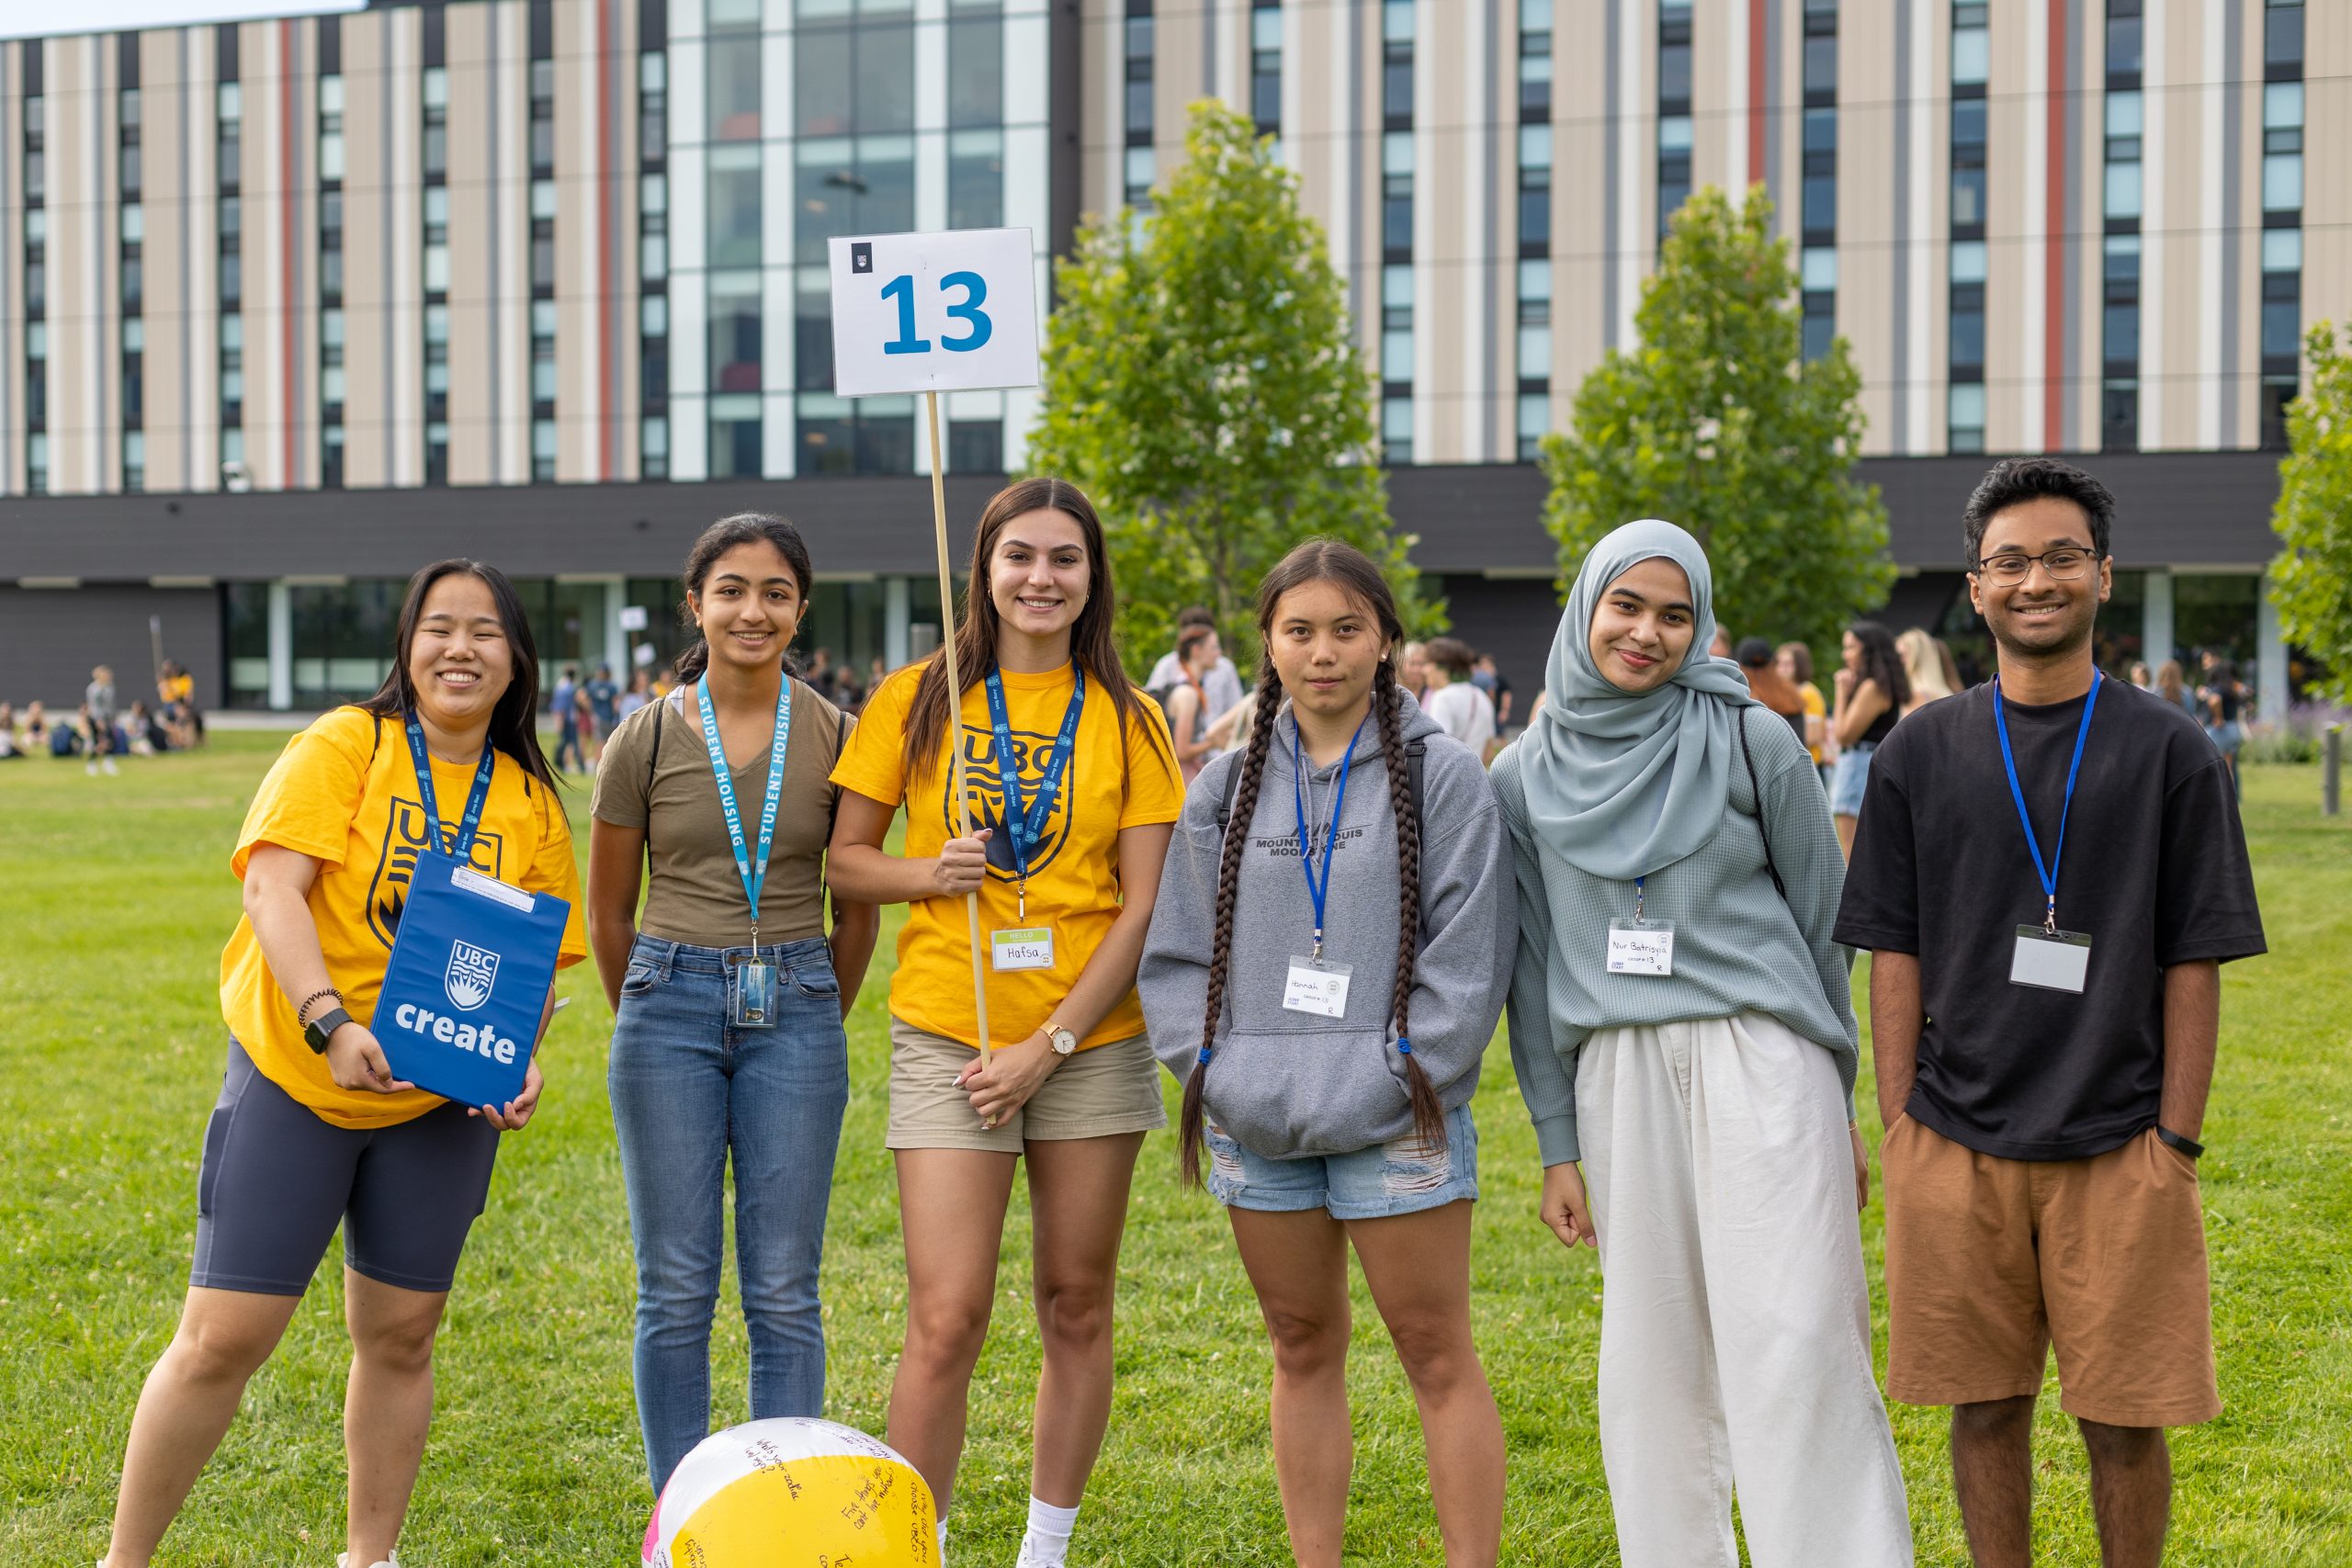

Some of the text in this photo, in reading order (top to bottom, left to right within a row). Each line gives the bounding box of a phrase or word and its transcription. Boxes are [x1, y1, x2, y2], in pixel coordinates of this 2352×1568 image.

[881, 271, 992, 355] 13
[699, 696, 743, 847] STUDENT HOUSING
[761, 694, 790, 844] STUDENT HOUSING
[965, 735, 1054, 773] UBC
[400, 808, 492, 872] UBC
[456, 944, 495, 971] UBC
[1008, 946, 1038, 958] Hafsa
[1612, 941, 1627, 950] Nur
[1292, 980, 1317, 990] Hannah
[395, 1003, 515, 1065] create
[766, 1454, 786, 1472] your
[785, 1473, 802, 1501] zodiac
[841, 1502, 860, 1519] Five
[919, 1540, 928, 1563] you
